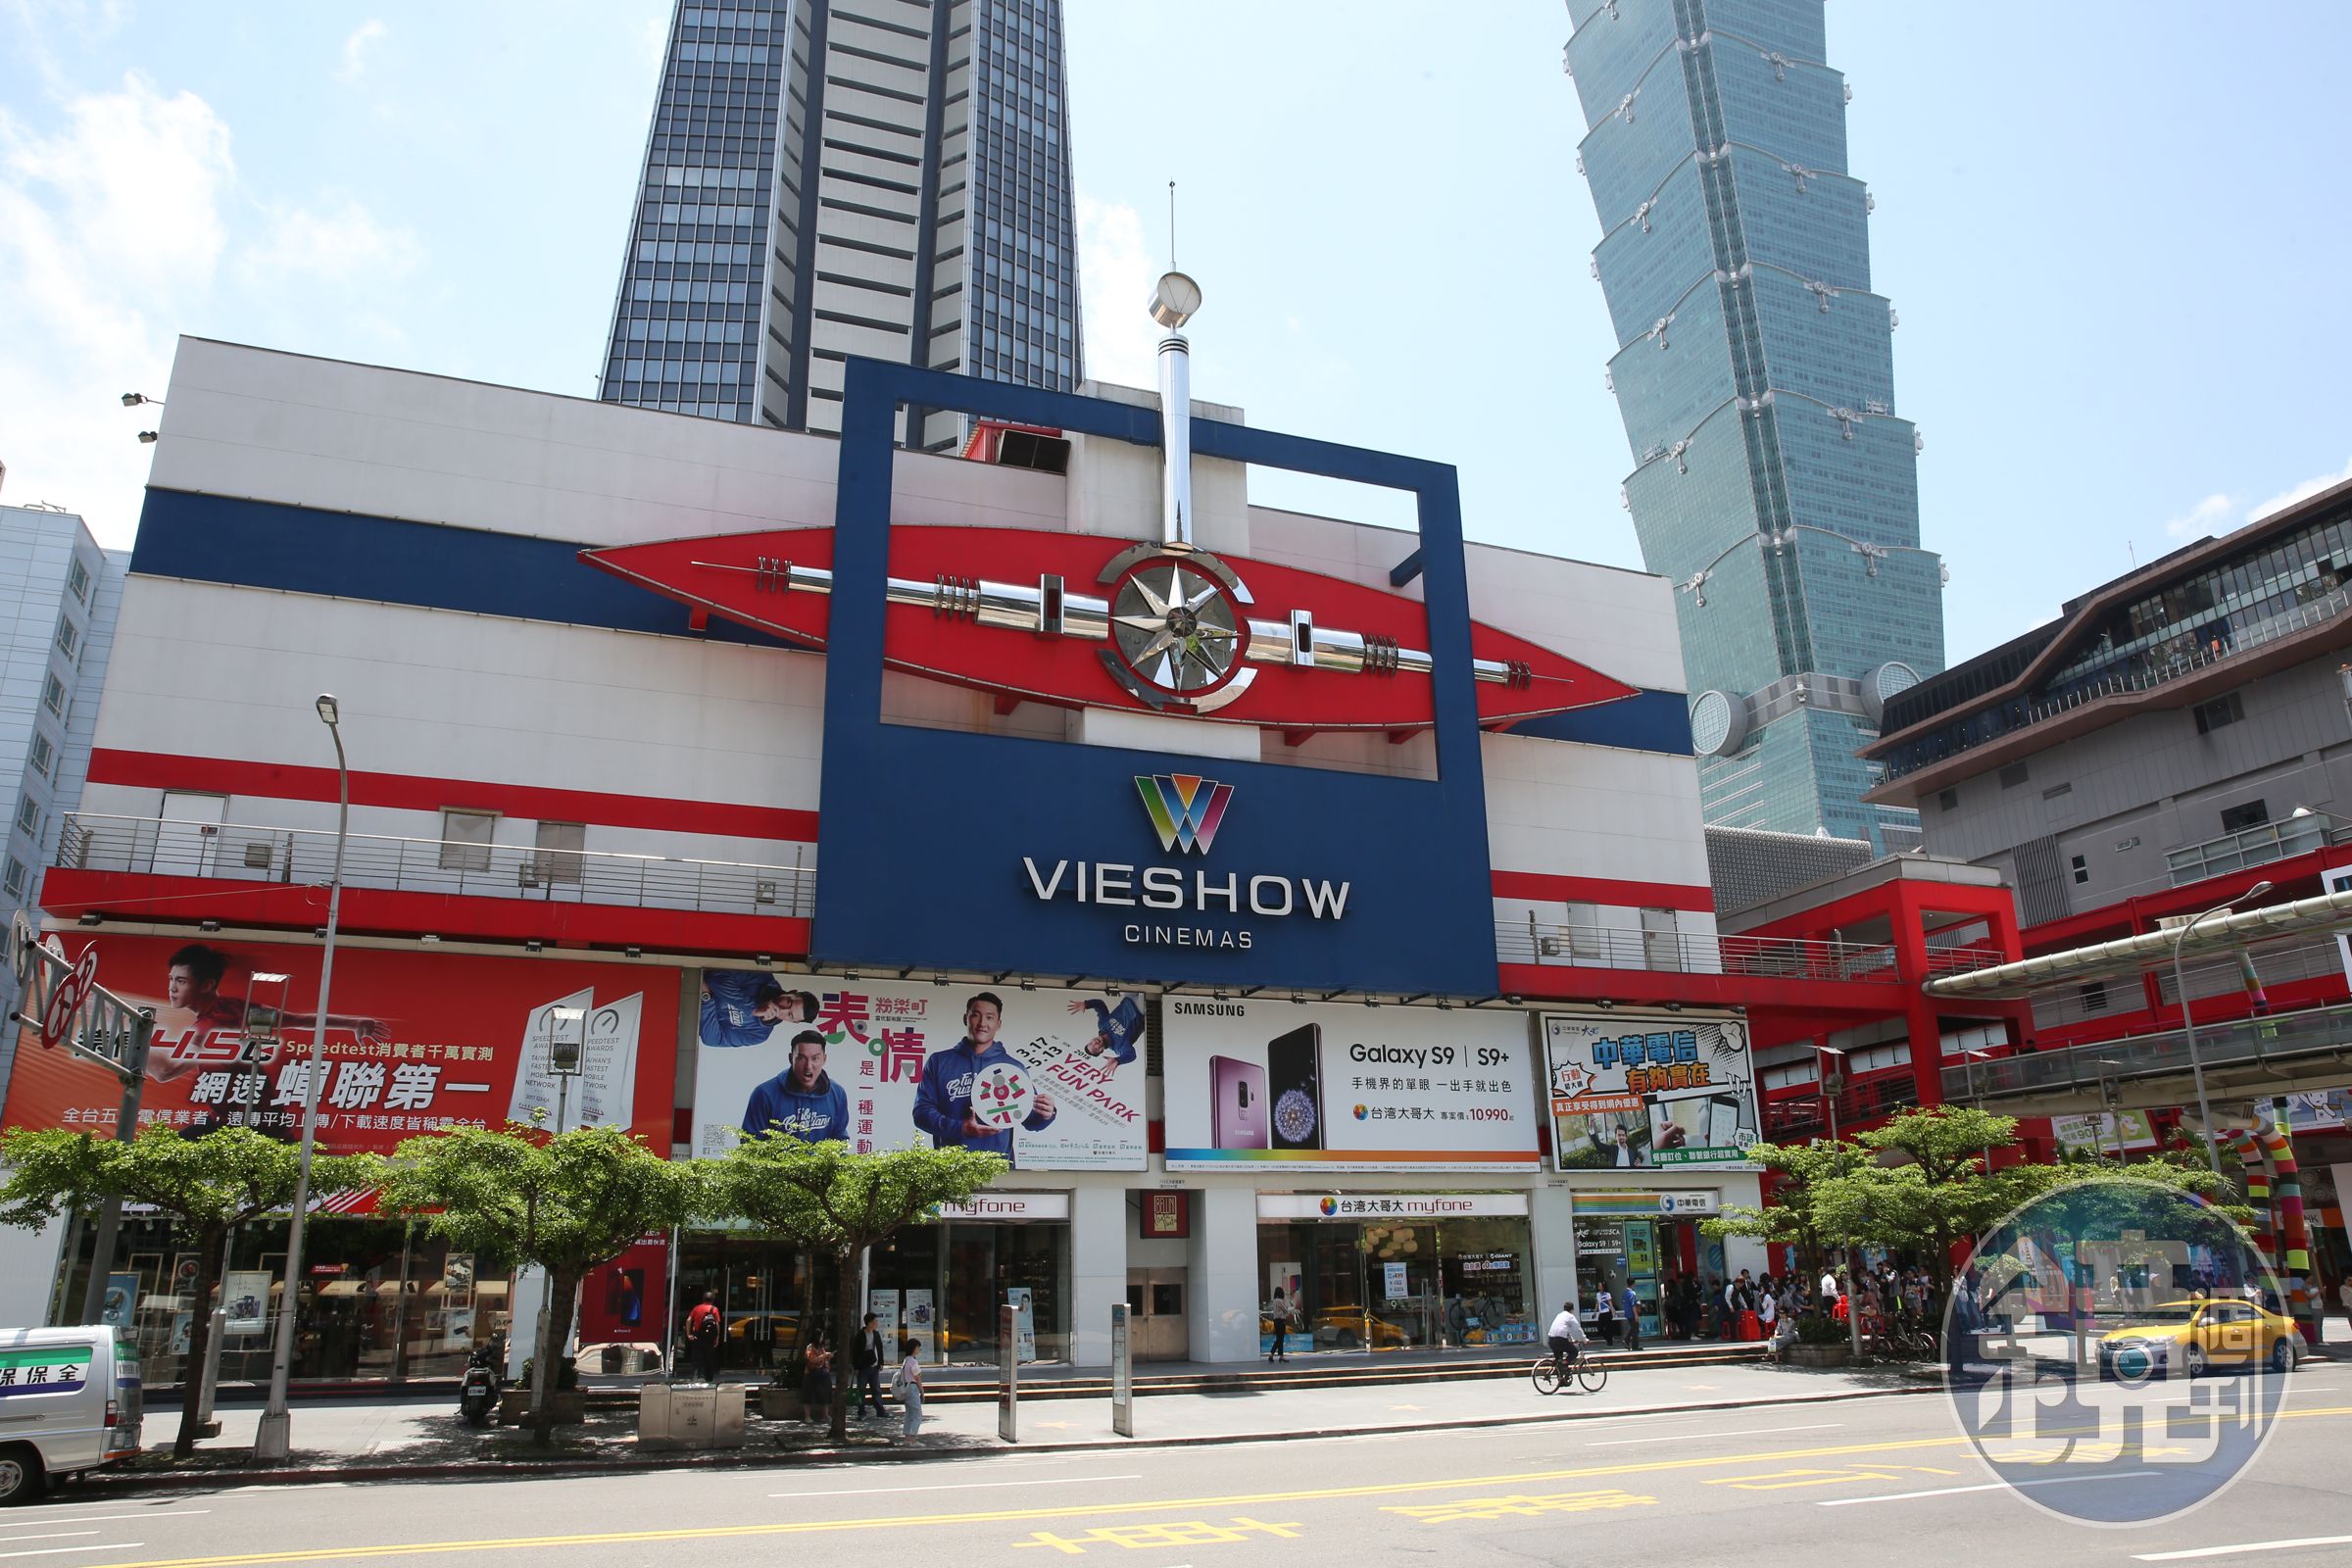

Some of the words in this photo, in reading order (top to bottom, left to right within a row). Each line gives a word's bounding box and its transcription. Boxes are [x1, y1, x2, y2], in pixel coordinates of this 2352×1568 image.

[1022, 857, 1350, 920] VIESHOW
[1125, 924, 1252, 949] CINEMAS
[1174, 1002, 1246, 1018] SAMSUNG
[1015, 1036, 1049, 1058] 3.17
[1349, 1043, 1427, 1069] Galaxy
[1431, 1046, 1455, 1065] S9
[1477, 1048, 1510, 1066] S9+
[1592, 1030, 1699, 1071] 中華電信
[1064, 1053, 1113, 1085] VERY
[190, 1071, 267, 1105] 網速
[525, 1080, 557, 1090] NETWORK
[1046, 1063, 1090, 1092] FUN
[1086, 1088, 1142, 1123] PARK
[1351, 1076, 1431, 1091] 手機界的單眼
[1437, 1078, 1512, 1093] 一出手就出色
[857, 1059, 875, 1155] 是一種運動
[944, 1198, 1026, 1216] myfone
[1407, 1199, 1474, 1216] myfone
[1677, 1199, 1706, 1207] 中華電信
[1577, 1240, 1599, 1249] Galaxy
